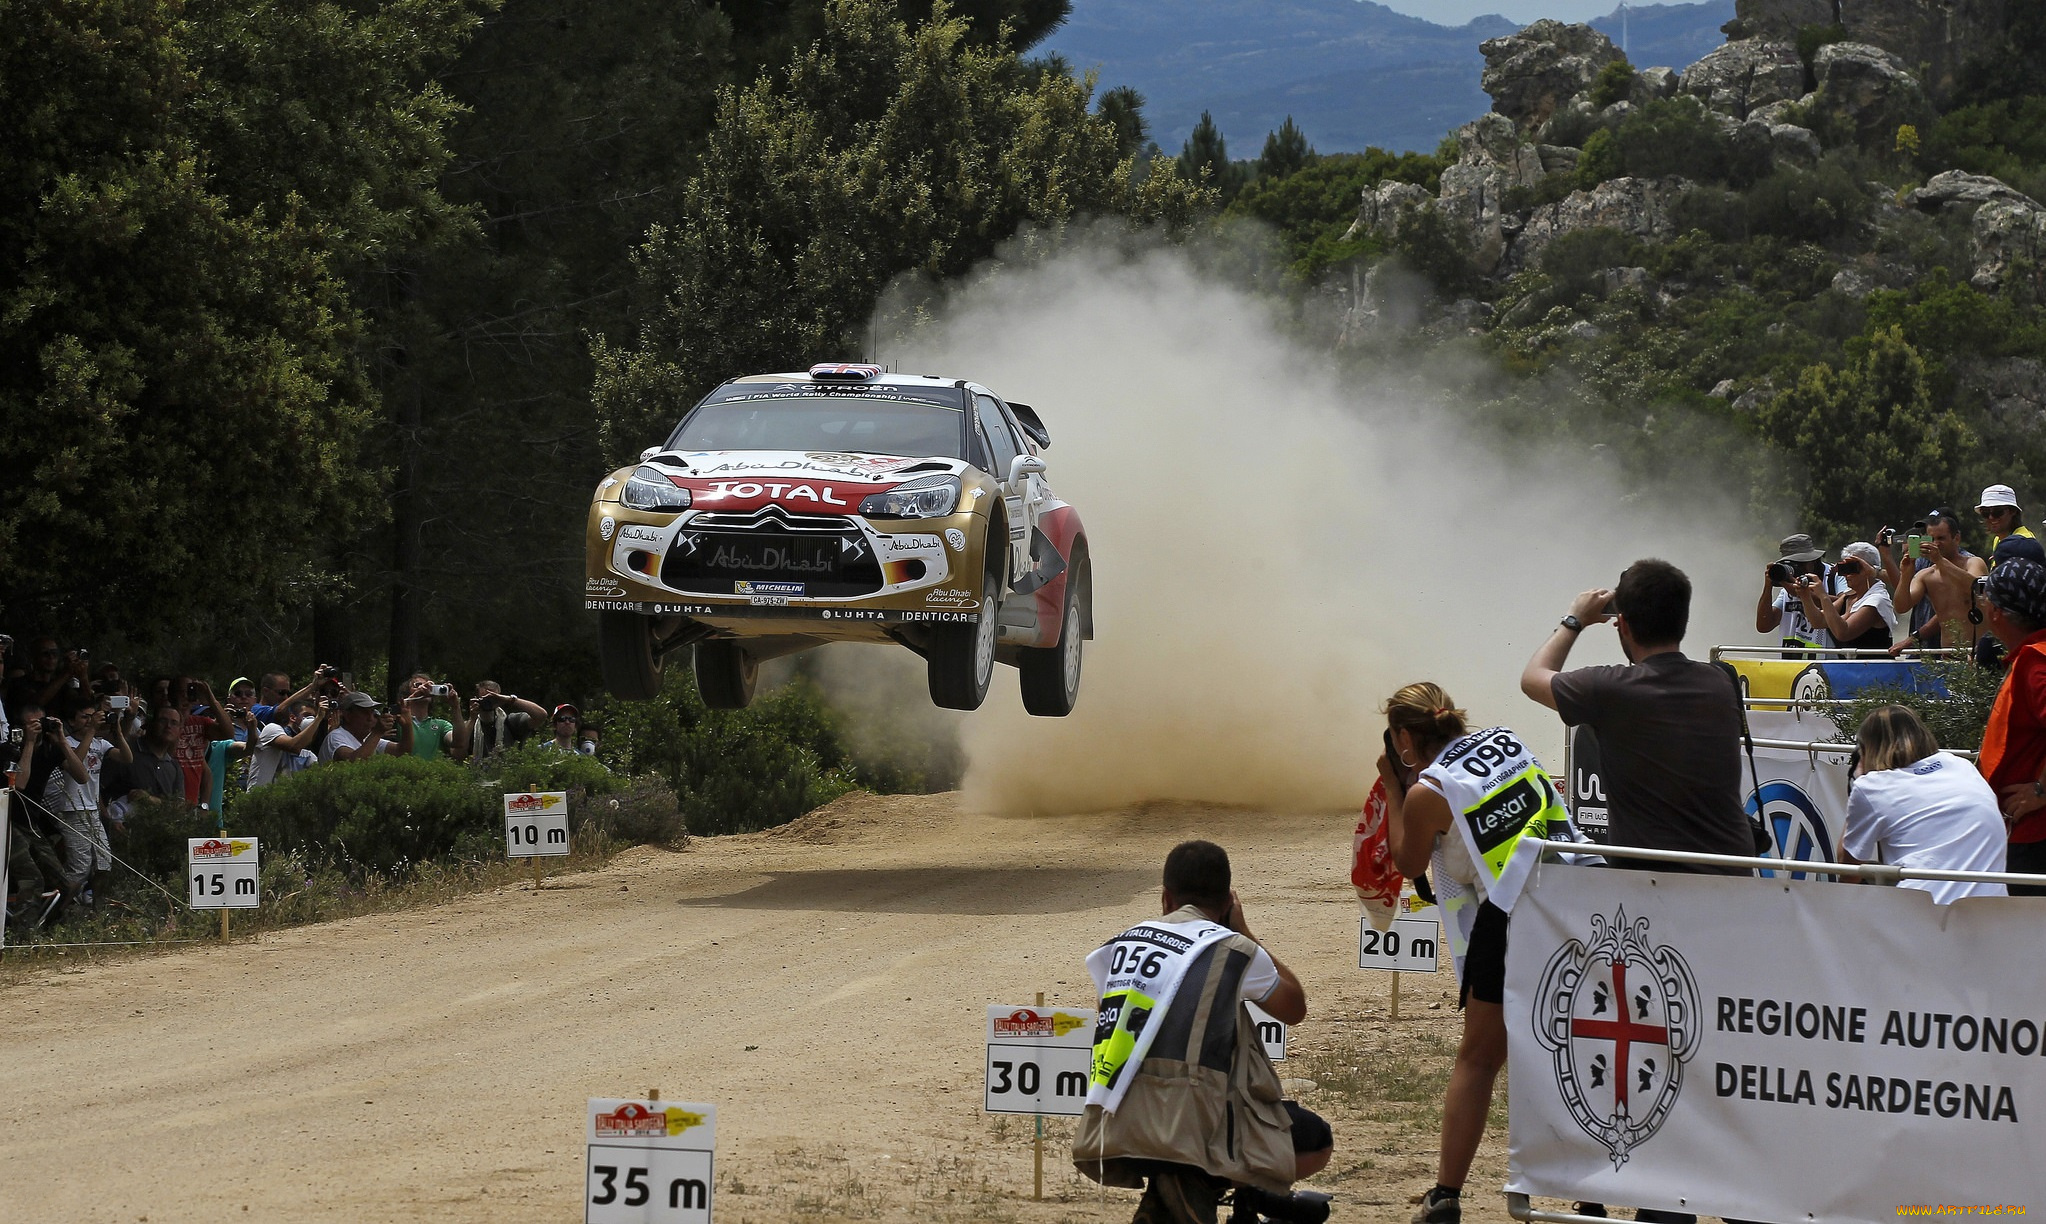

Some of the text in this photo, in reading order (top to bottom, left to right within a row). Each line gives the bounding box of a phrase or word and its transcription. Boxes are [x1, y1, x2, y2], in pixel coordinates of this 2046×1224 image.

[802, 391, 827, 399] Rally
[829, 391, 897, 401] Championship
[708, 480, 847, 507] TOTAL
[756, 584, 803, 592] MICHELIN
[933, 588, 972, 598] Abu Dhabi
[585, 600, 635, 611] IDENTICAR
[664, 605, 713, 614] LUHTA
[926, 593, 969, 607] Racing
[834, 611, 885, 619] LUHTA
[901, 612, 968, 622] IDENTICAR
[1462, 735, 1523, 778] 098
[1481, 759, 1530, 793] PHOTOGRAPHER
[1476, 793, 1528, 836] Lexar
[510, 825, 566, 845] 10 m
[193, 873, 256, 896] 15 m
[1363, 930, 1435, 959] 20 m
[1110, 945, 1169, 979] 056
[1257, 1021, 1282, 1043] m
[1717, 996, 2046, 1058] REGIONE AUTONO
[990, 1061, 1088, 1097] 30 m
[1715, 1062, 2019, 1123] DELLA SARDEGNA
[592, 1165, 707, 1210] 35 m
